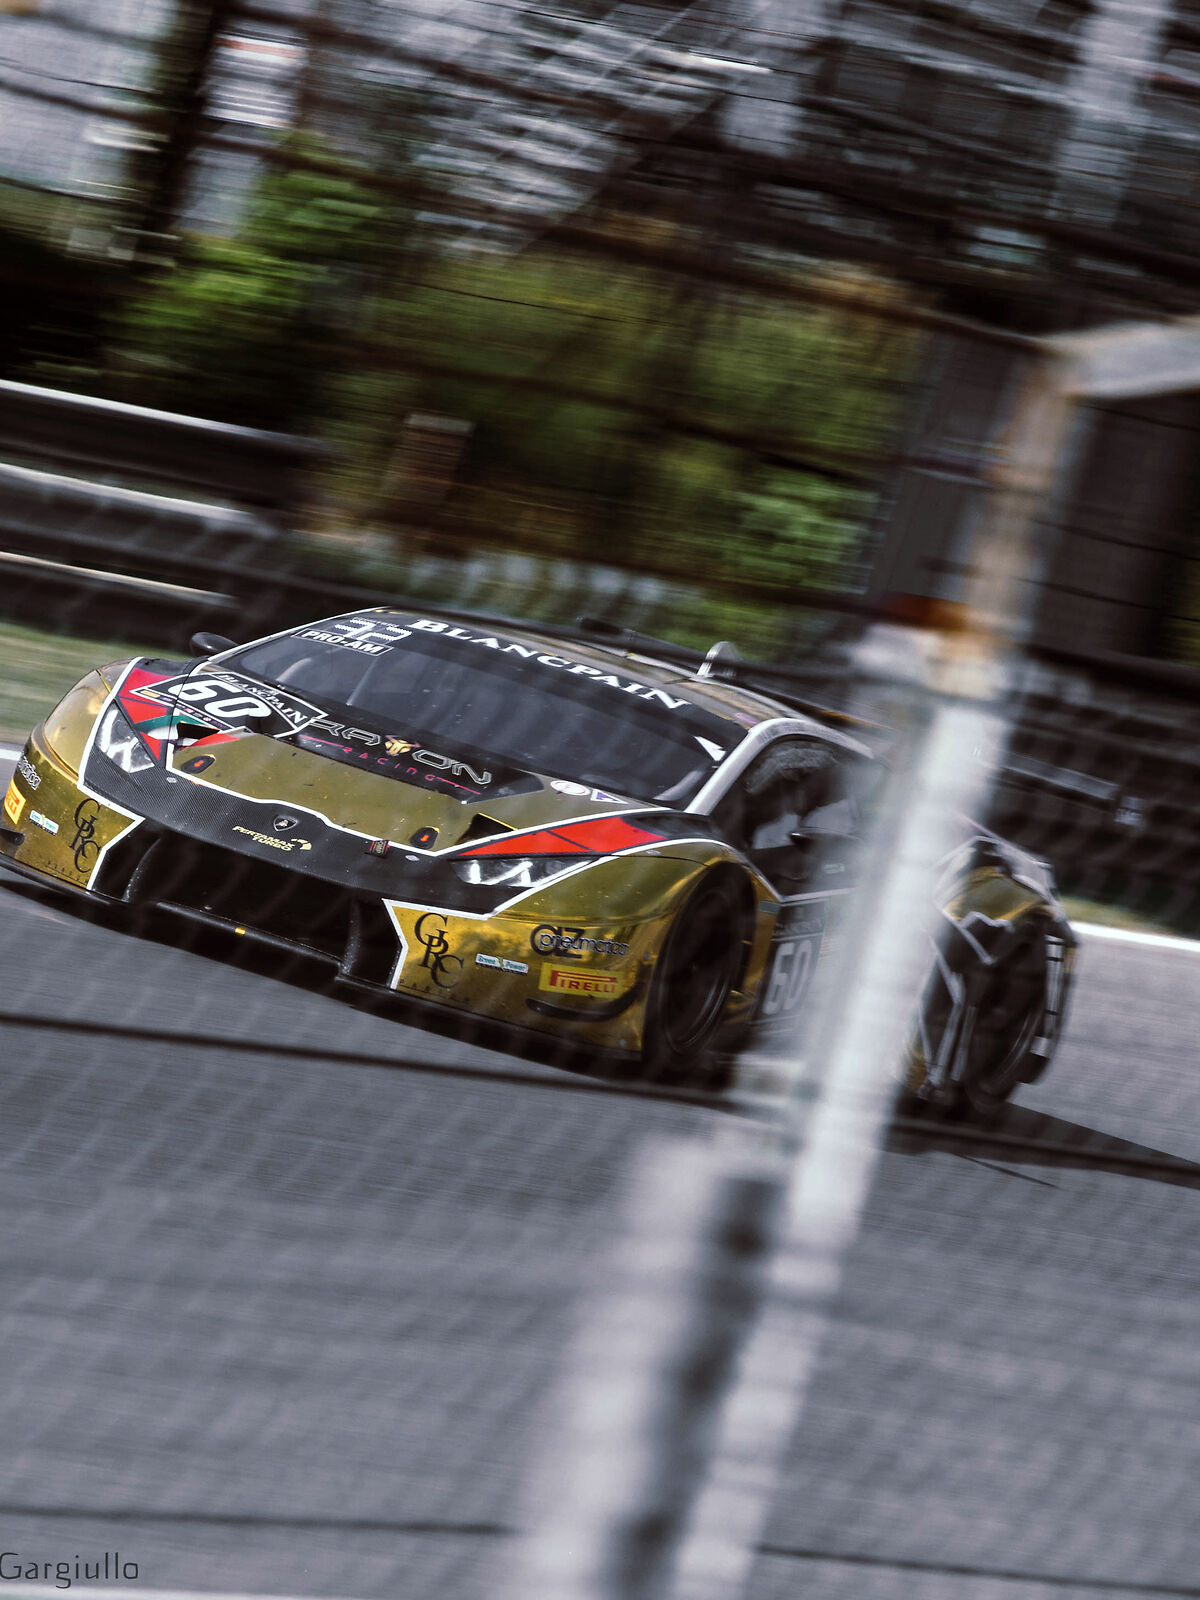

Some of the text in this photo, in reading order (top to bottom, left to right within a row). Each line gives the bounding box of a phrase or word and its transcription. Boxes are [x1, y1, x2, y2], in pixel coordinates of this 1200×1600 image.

[301, 630, 384, 653] PRO-AM
[405, 619, 692, 709] BLANCPAIN
[168, 679, 272, 718] 60
[218, 674, 308, 724] BLANCPAIN
[252, 836, 292, 851] TURBO
[549, 969, 618, 993] PIRELLI
